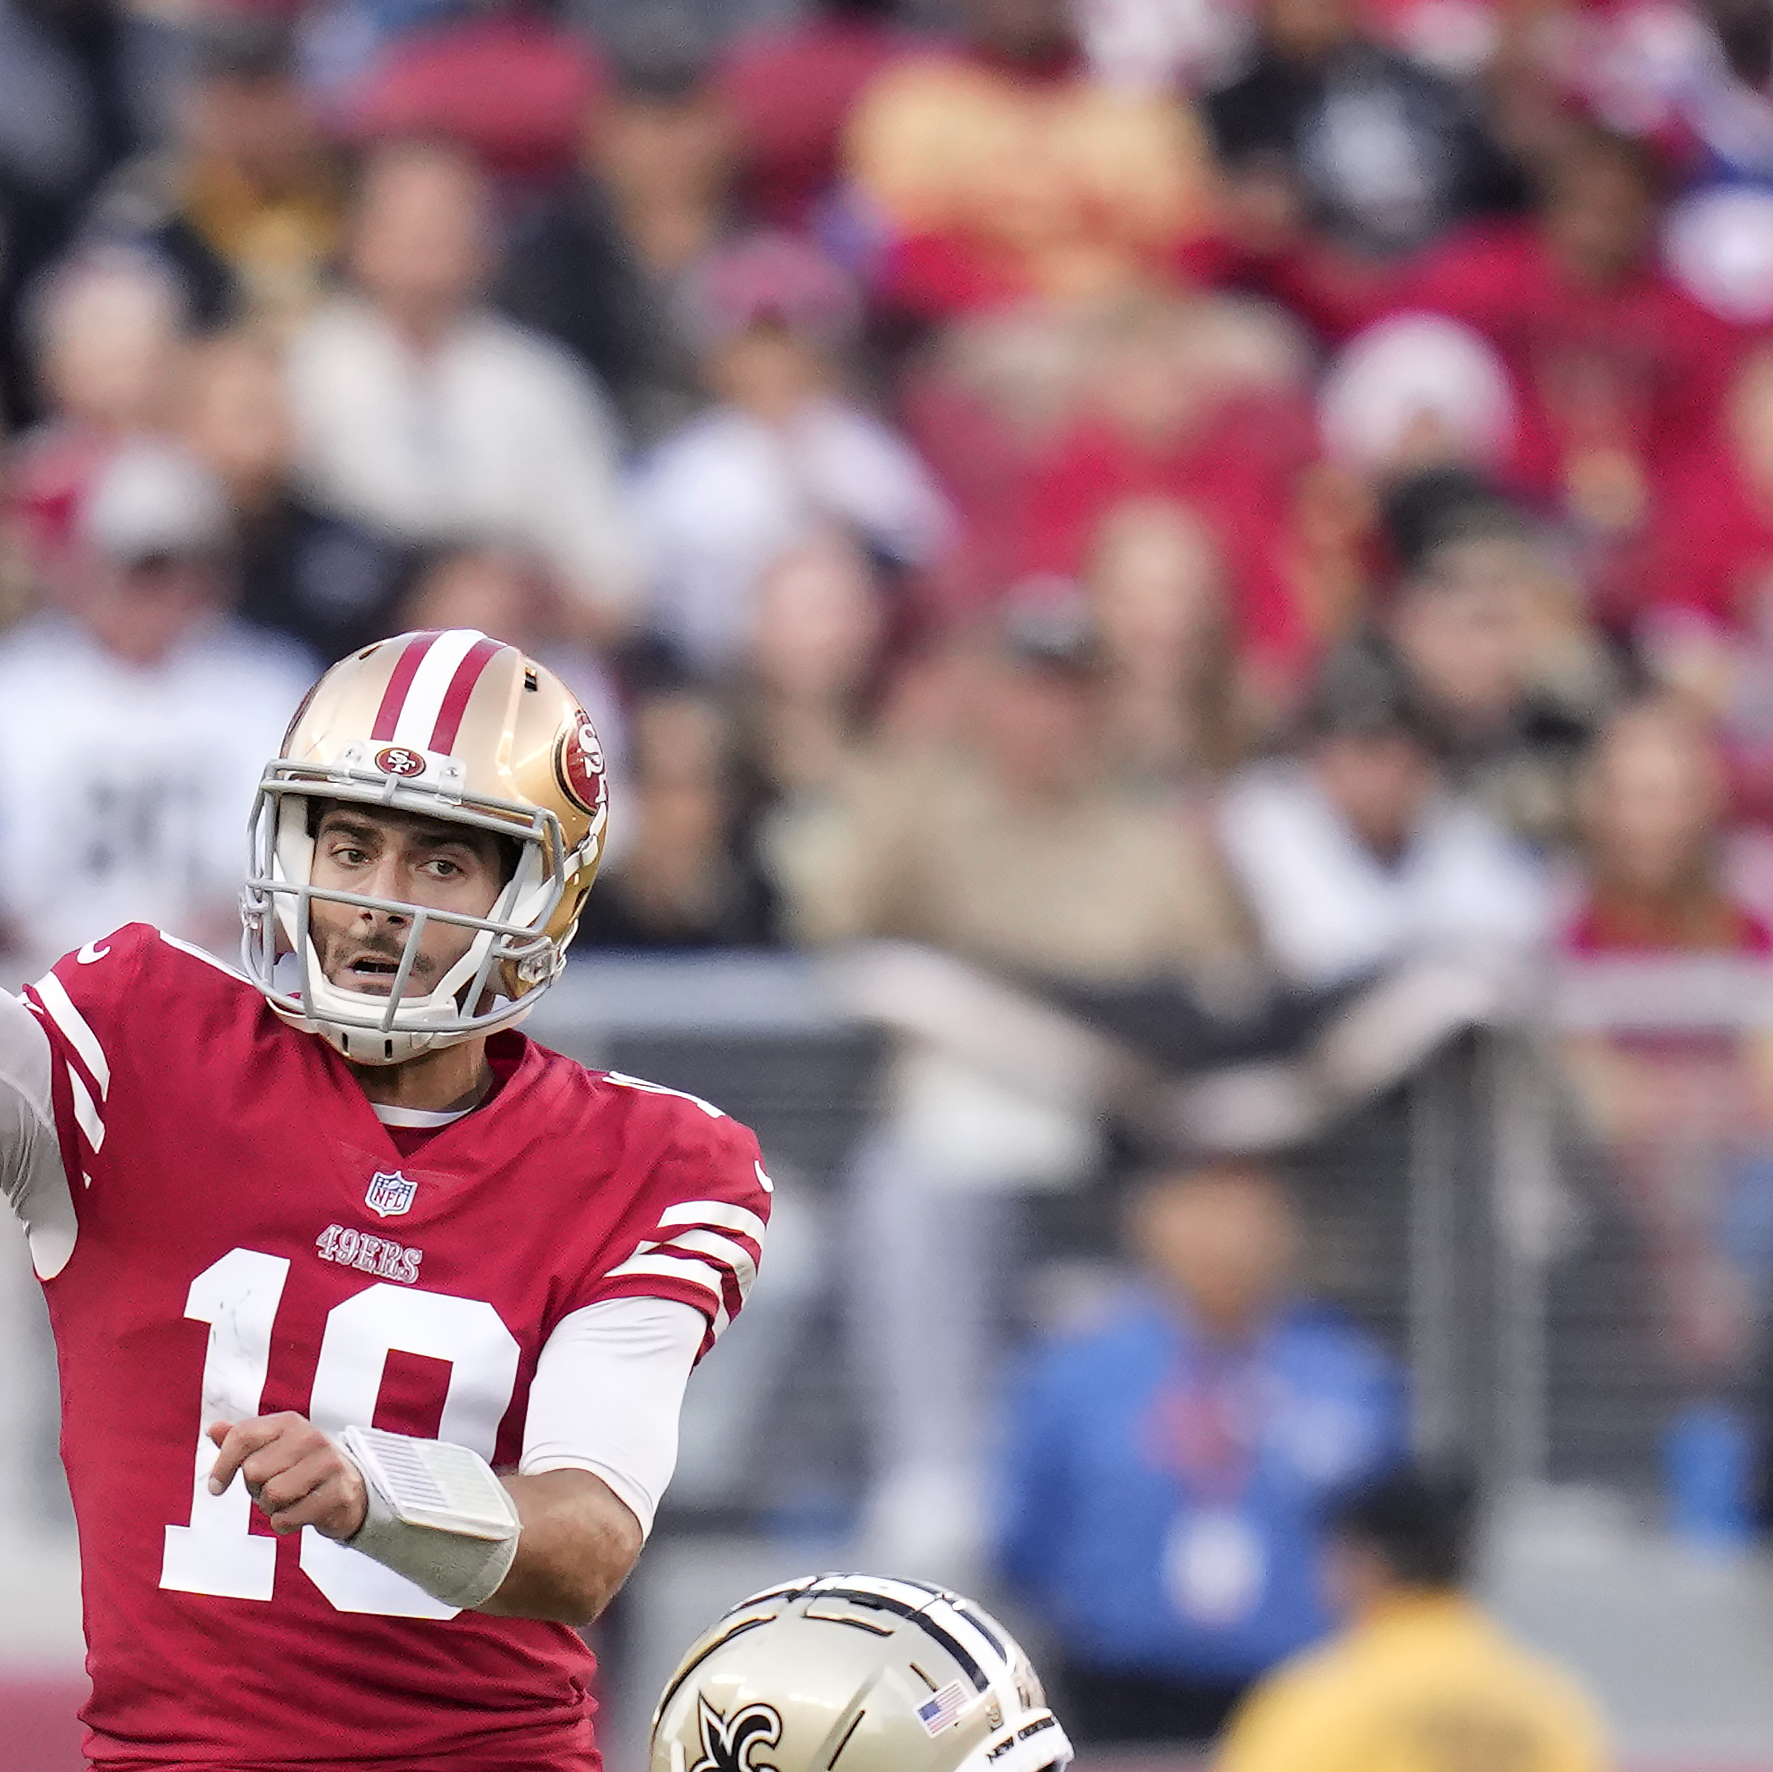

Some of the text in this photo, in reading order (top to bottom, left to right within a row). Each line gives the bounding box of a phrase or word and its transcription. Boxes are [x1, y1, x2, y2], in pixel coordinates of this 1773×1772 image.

[372, 1186, 406, 1209] NFL
[315, 1223, 423, 1284] 49ERS
[158, 1246, 522, 1622] 10
